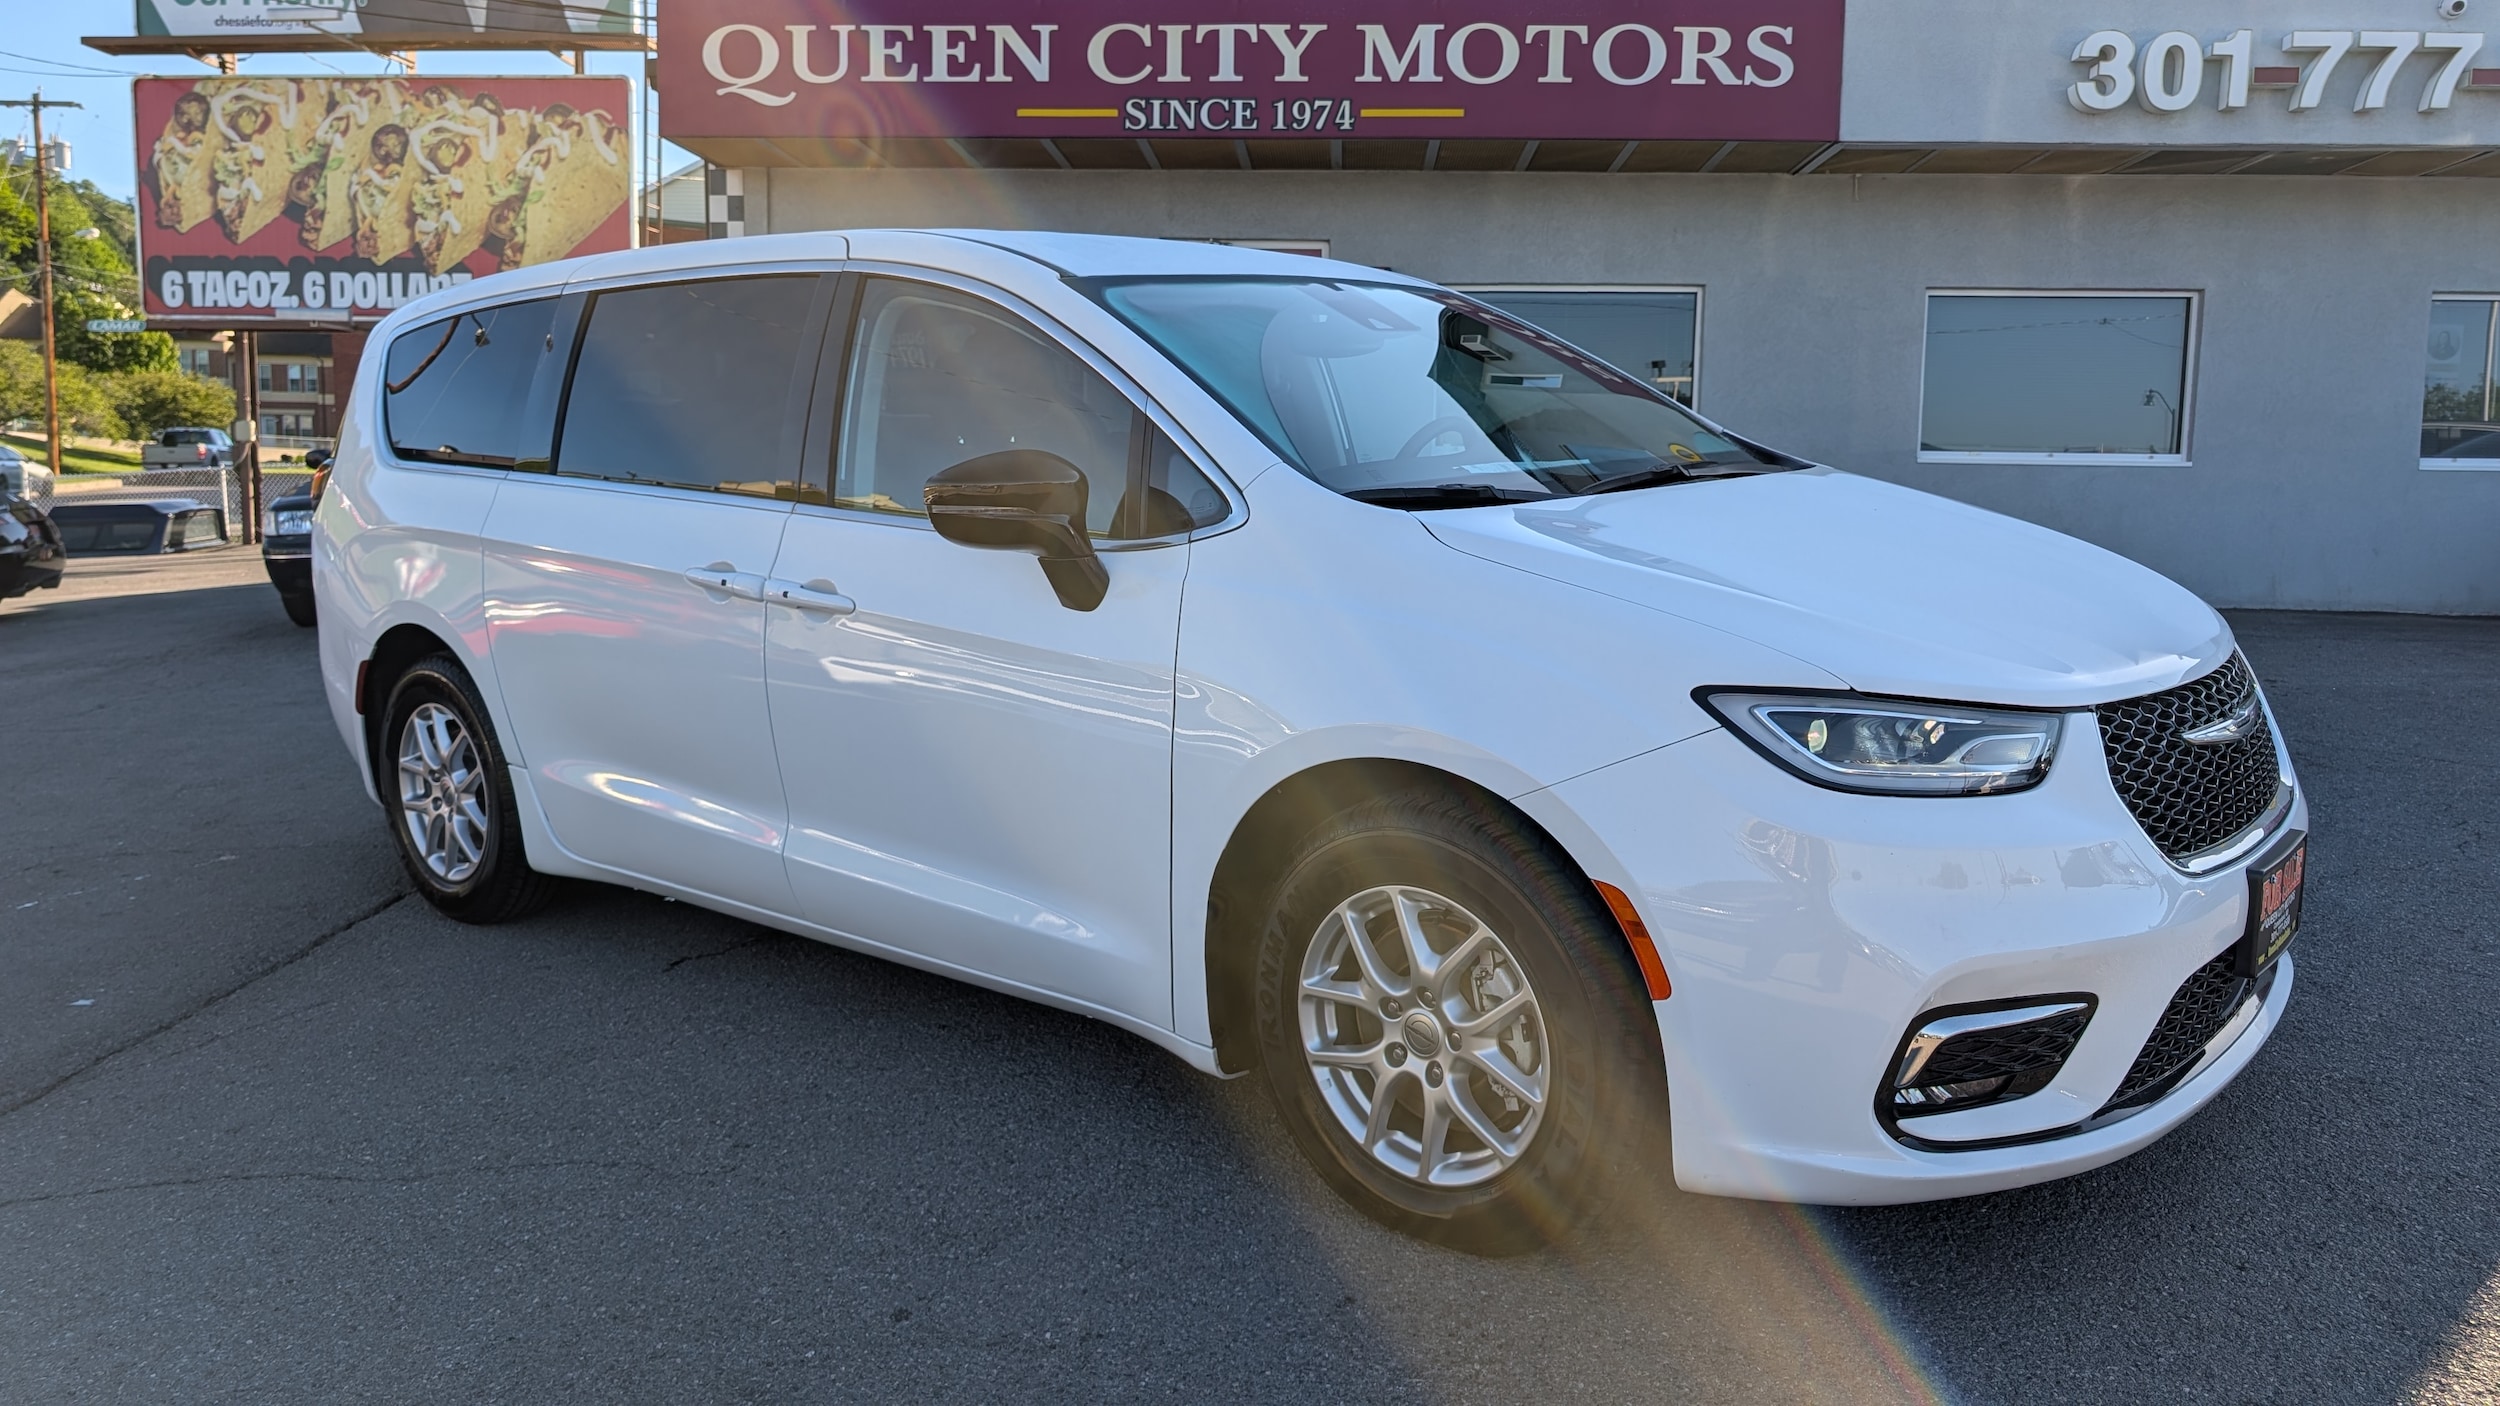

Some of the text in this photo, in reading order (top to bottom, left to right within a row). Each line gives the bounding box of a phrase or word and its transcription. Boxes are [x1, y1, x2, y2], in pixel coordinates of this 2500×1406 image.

[702, 22, 1796, 107] QUEEN CITY MOTORS
[1123, 98, 1356, 132] SINCE 1974
[161, 270, 185, 308] 6
[187, 270, 299, 309] TACOZ.
[302, 270, 326, 309] 6
